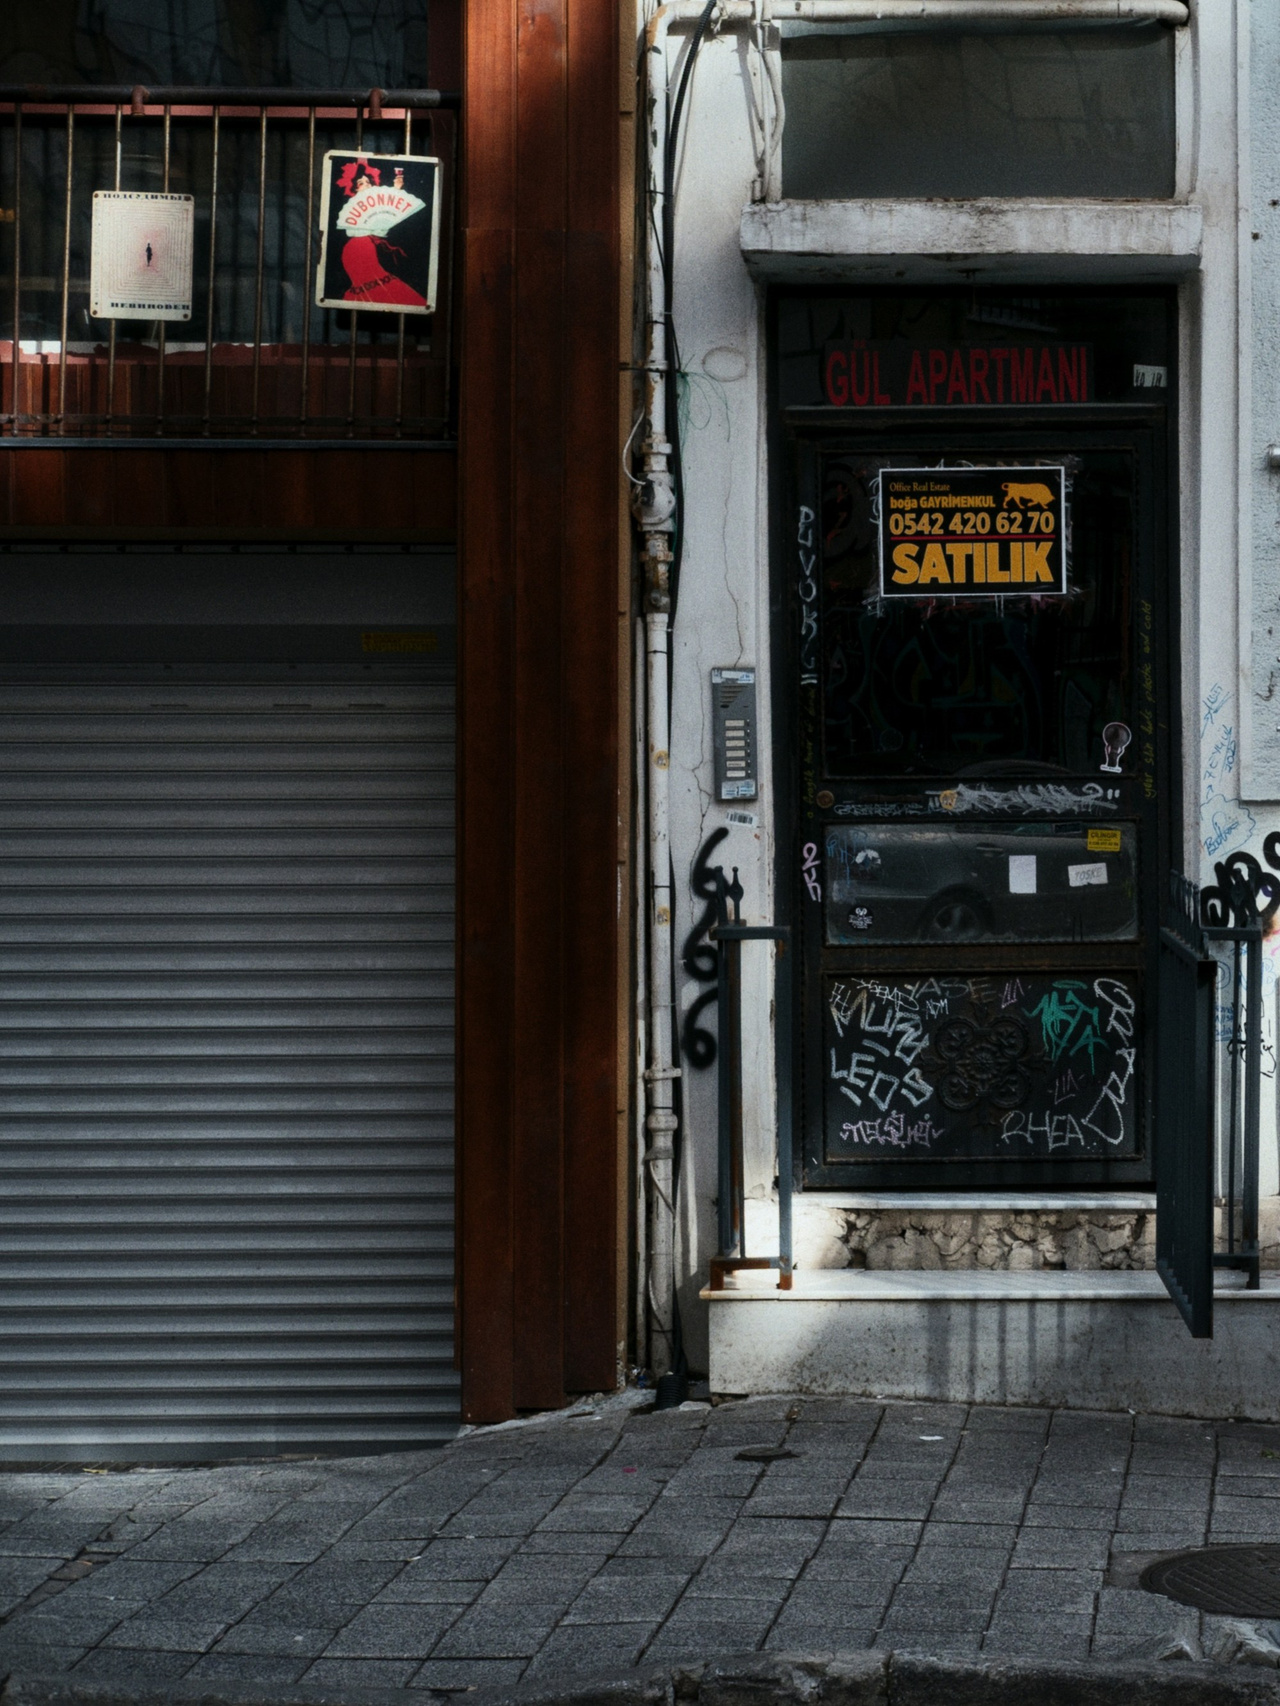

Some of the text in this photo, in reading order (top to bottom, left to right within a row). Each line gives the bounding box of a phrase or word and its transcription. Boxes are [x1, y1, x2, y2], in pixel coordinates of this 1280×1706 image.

[103, 192, 191, 202] ПОДСУДИМЫ
[345, 193, 413, 226] DUBONNET
[825, 338, 1088, 406] GÜL APARTMANI
[889, 482, 950, 492] Office Real Estate
[889, 493, 996, 511] boğa GAYRİMENKUL
[889, 511, 1055, 535] 0542 420 62 70
[891, 541, 1054, 585] SATILIK
